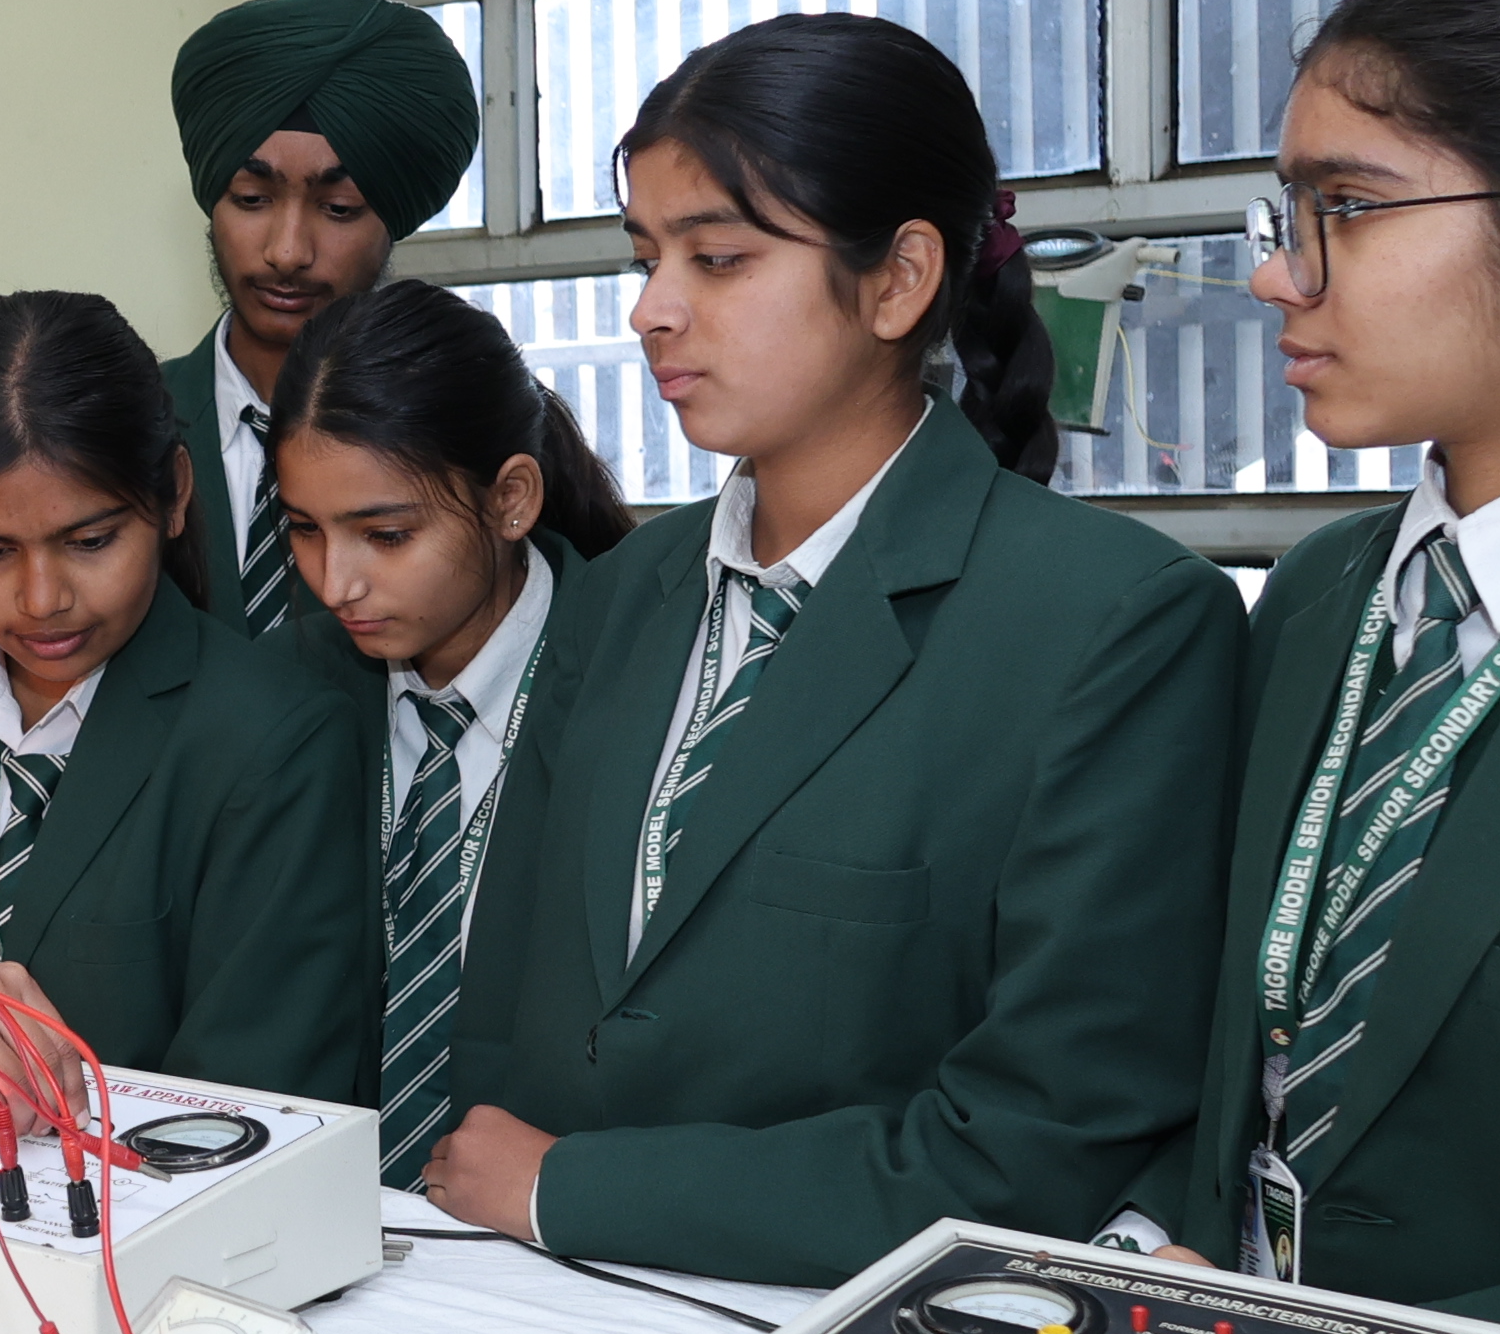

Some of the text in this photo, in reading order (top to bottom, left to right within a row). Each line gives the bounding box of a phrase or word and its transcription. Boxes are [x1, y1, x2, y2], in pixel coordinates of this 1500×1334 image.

[706, 584, 725, 653] SCHOOL
[681, 657, 718, 751] SECONDARY
[655, 748, 691, 809] SENIOR
[1263, 574, 1387, 1013] TAGORE MODEL SENIOR SECONDARY SCHOO
[646, 809, 667, 871] MODEL
[1296, 930, 1331, 1005] TAGORE
[1322, 863, 1366, 932] MODEL
[1356, 785, 1413, 864] SENIOR
[137, 1087, 247, 1114] APPARATUS
[1042, 1263, 1132, 1293] JUNCTION
[1129, 1280, 1194, 1305] DIODE
